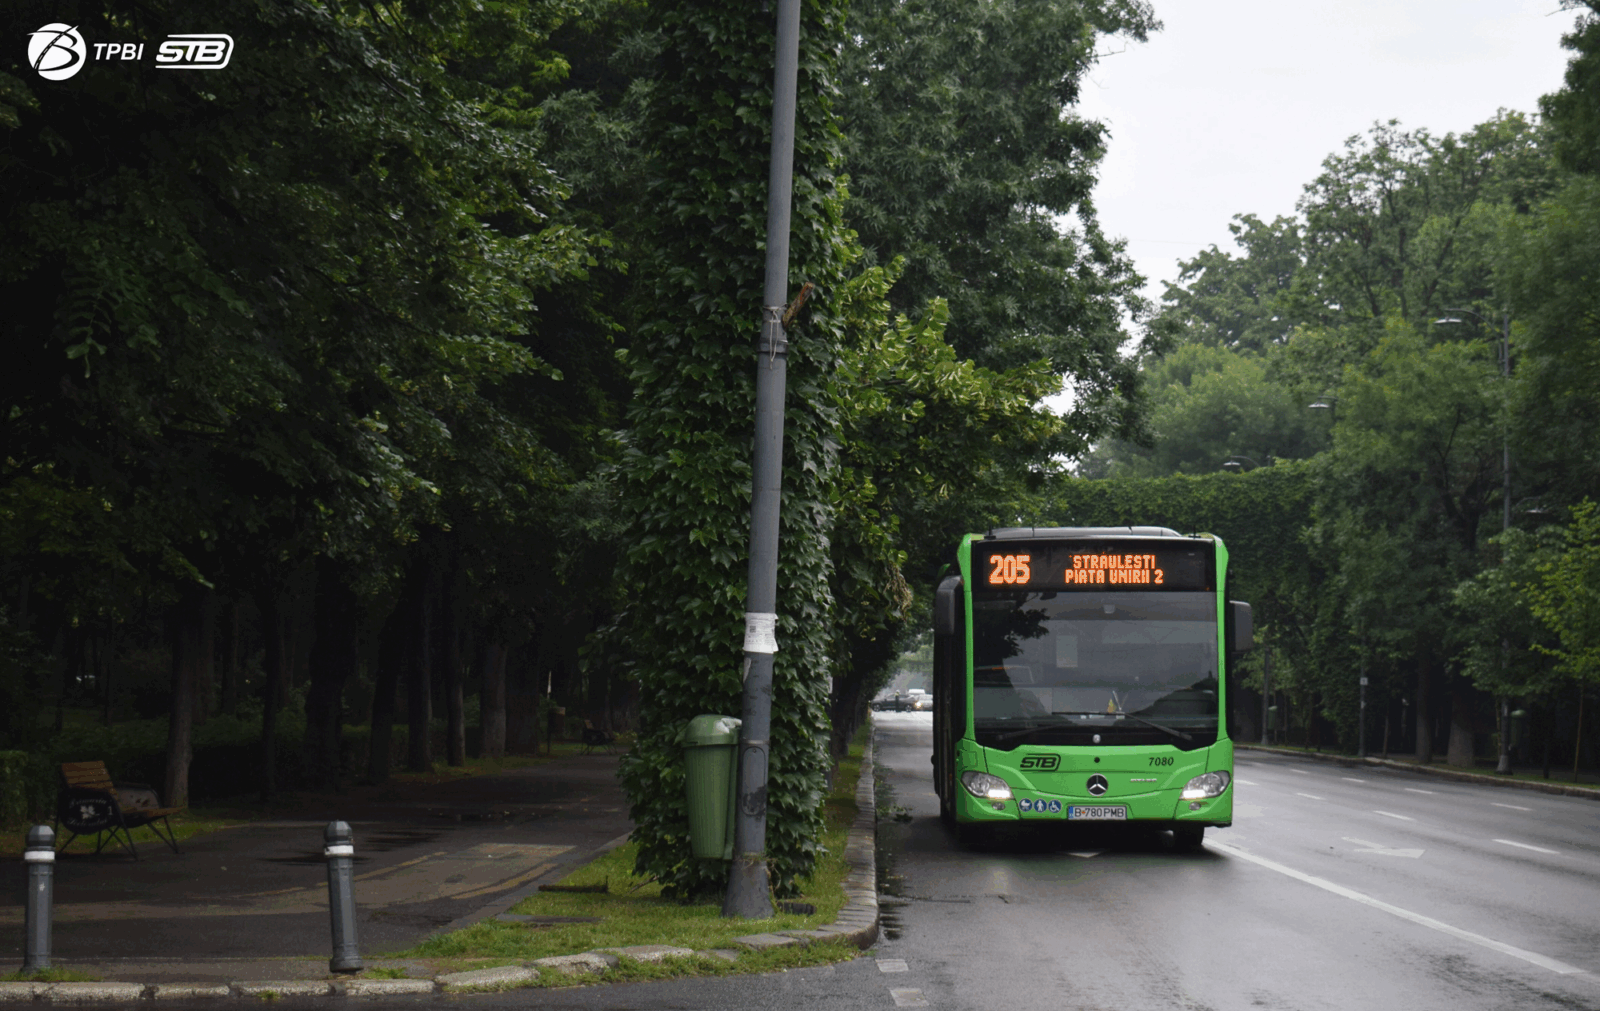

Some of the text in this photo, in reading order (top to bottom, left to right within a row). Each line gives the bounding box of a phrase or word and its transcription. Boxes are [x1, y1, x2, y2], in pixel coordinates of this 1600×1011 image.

[989, 555, 1030, 584] 205
[1065, 569, 1164, 584] PIATA UNIRII 2
[1020, 756, 1057, 769] STB
[1148, 756, 1174, 767] 7080
